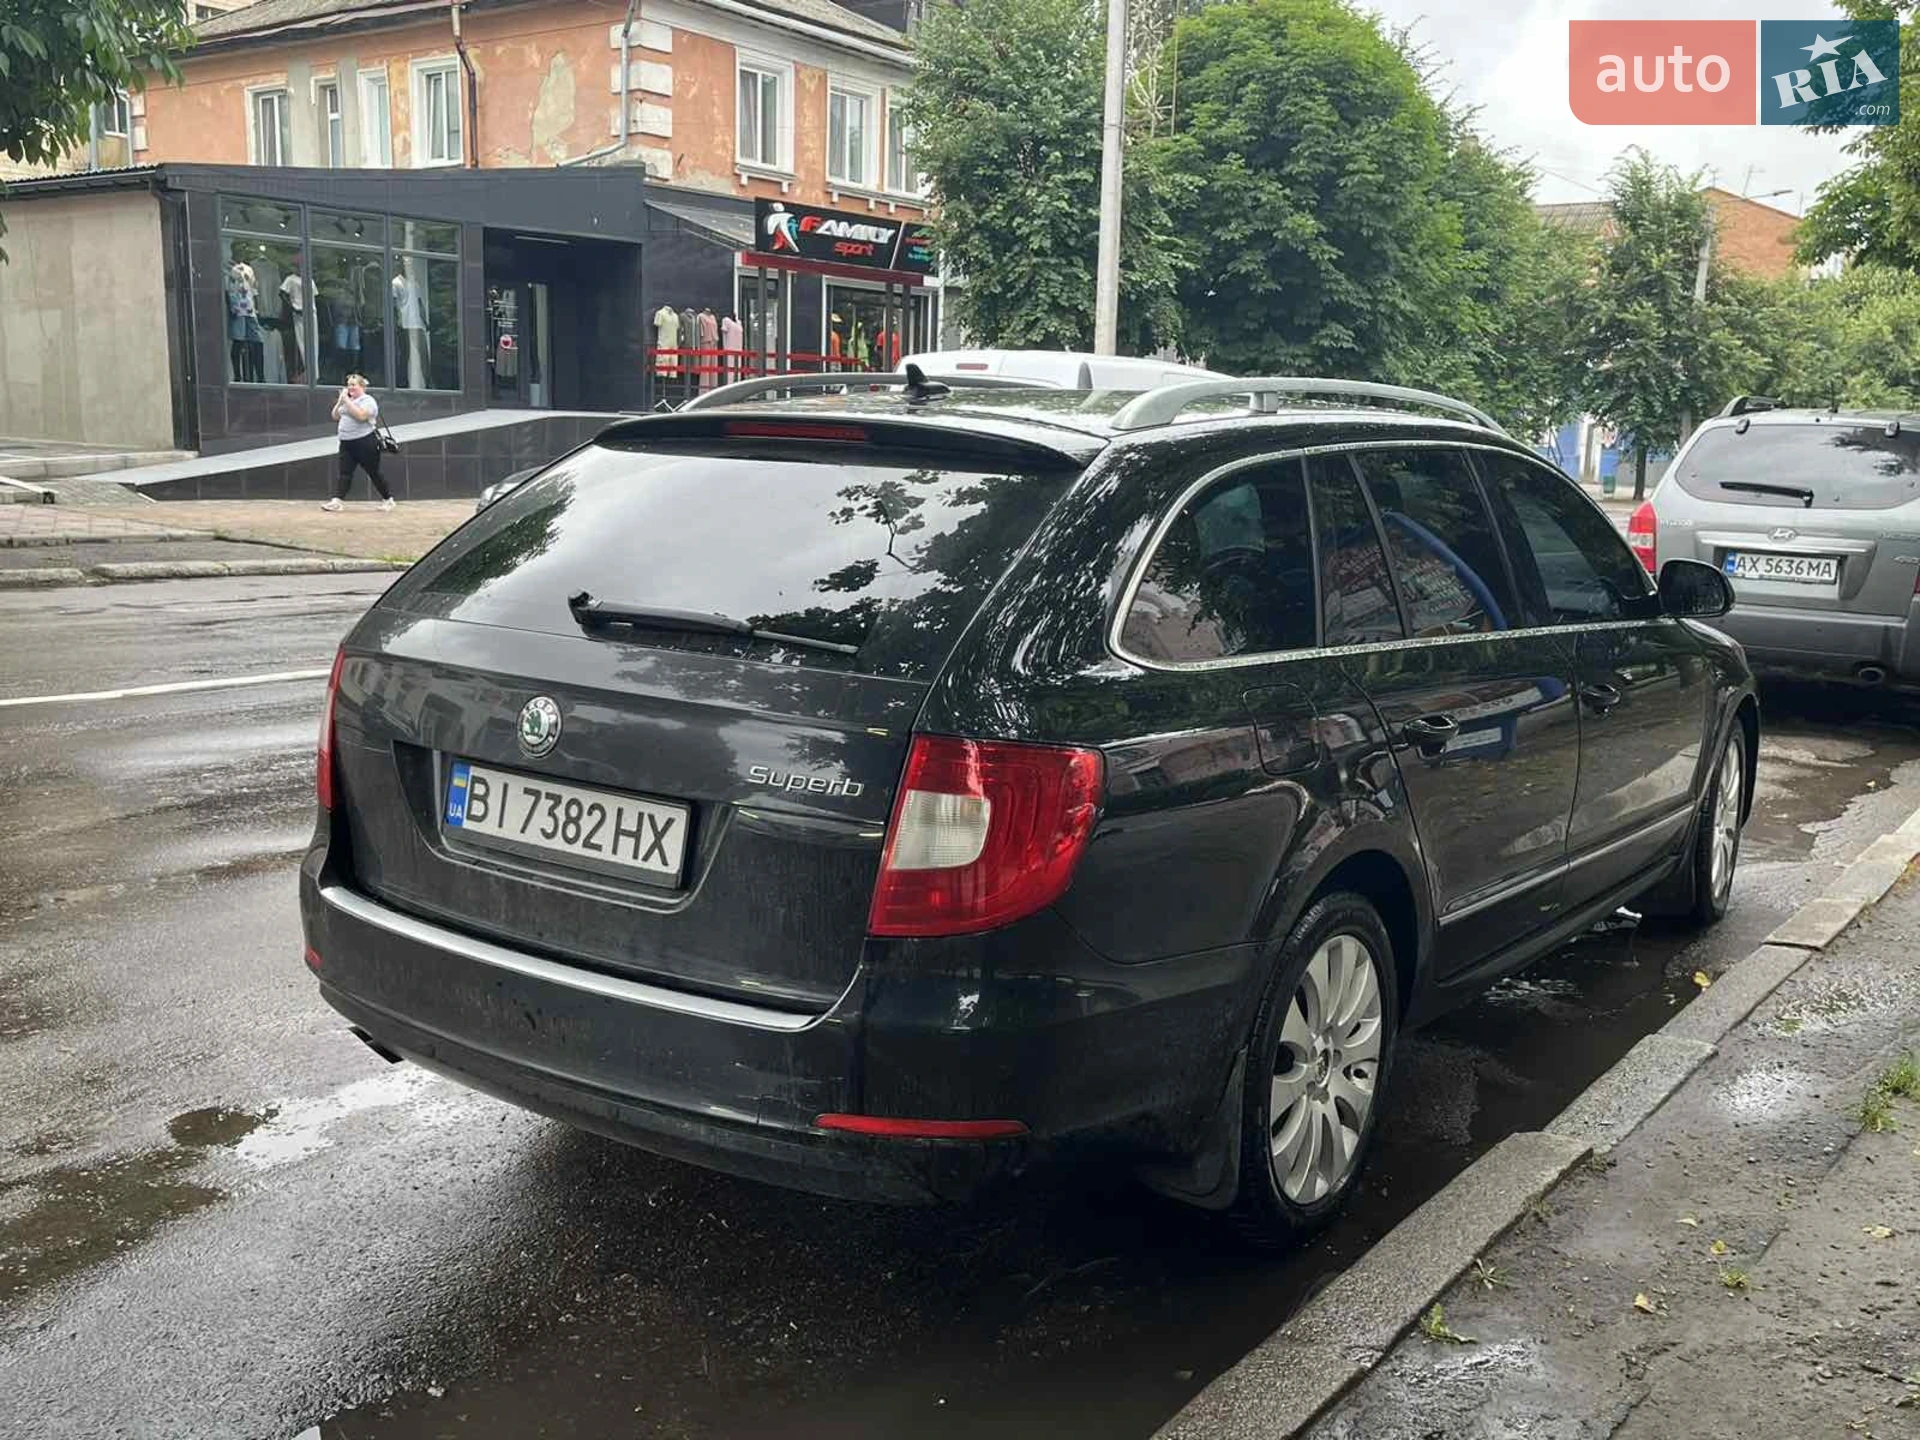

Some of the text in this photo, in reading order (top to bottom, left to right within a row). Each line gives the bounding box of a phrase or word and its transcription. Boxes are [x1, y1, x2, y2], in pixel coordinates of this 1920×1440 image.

[834, 241, 874, 256] sport
[1735, 556, 1833, 578] AX 5636 MA
[747, 765, 864, 797] Superb
[449, 802, 463, 819] UA
[465, 775, 676, 867] BI 7382 HX
